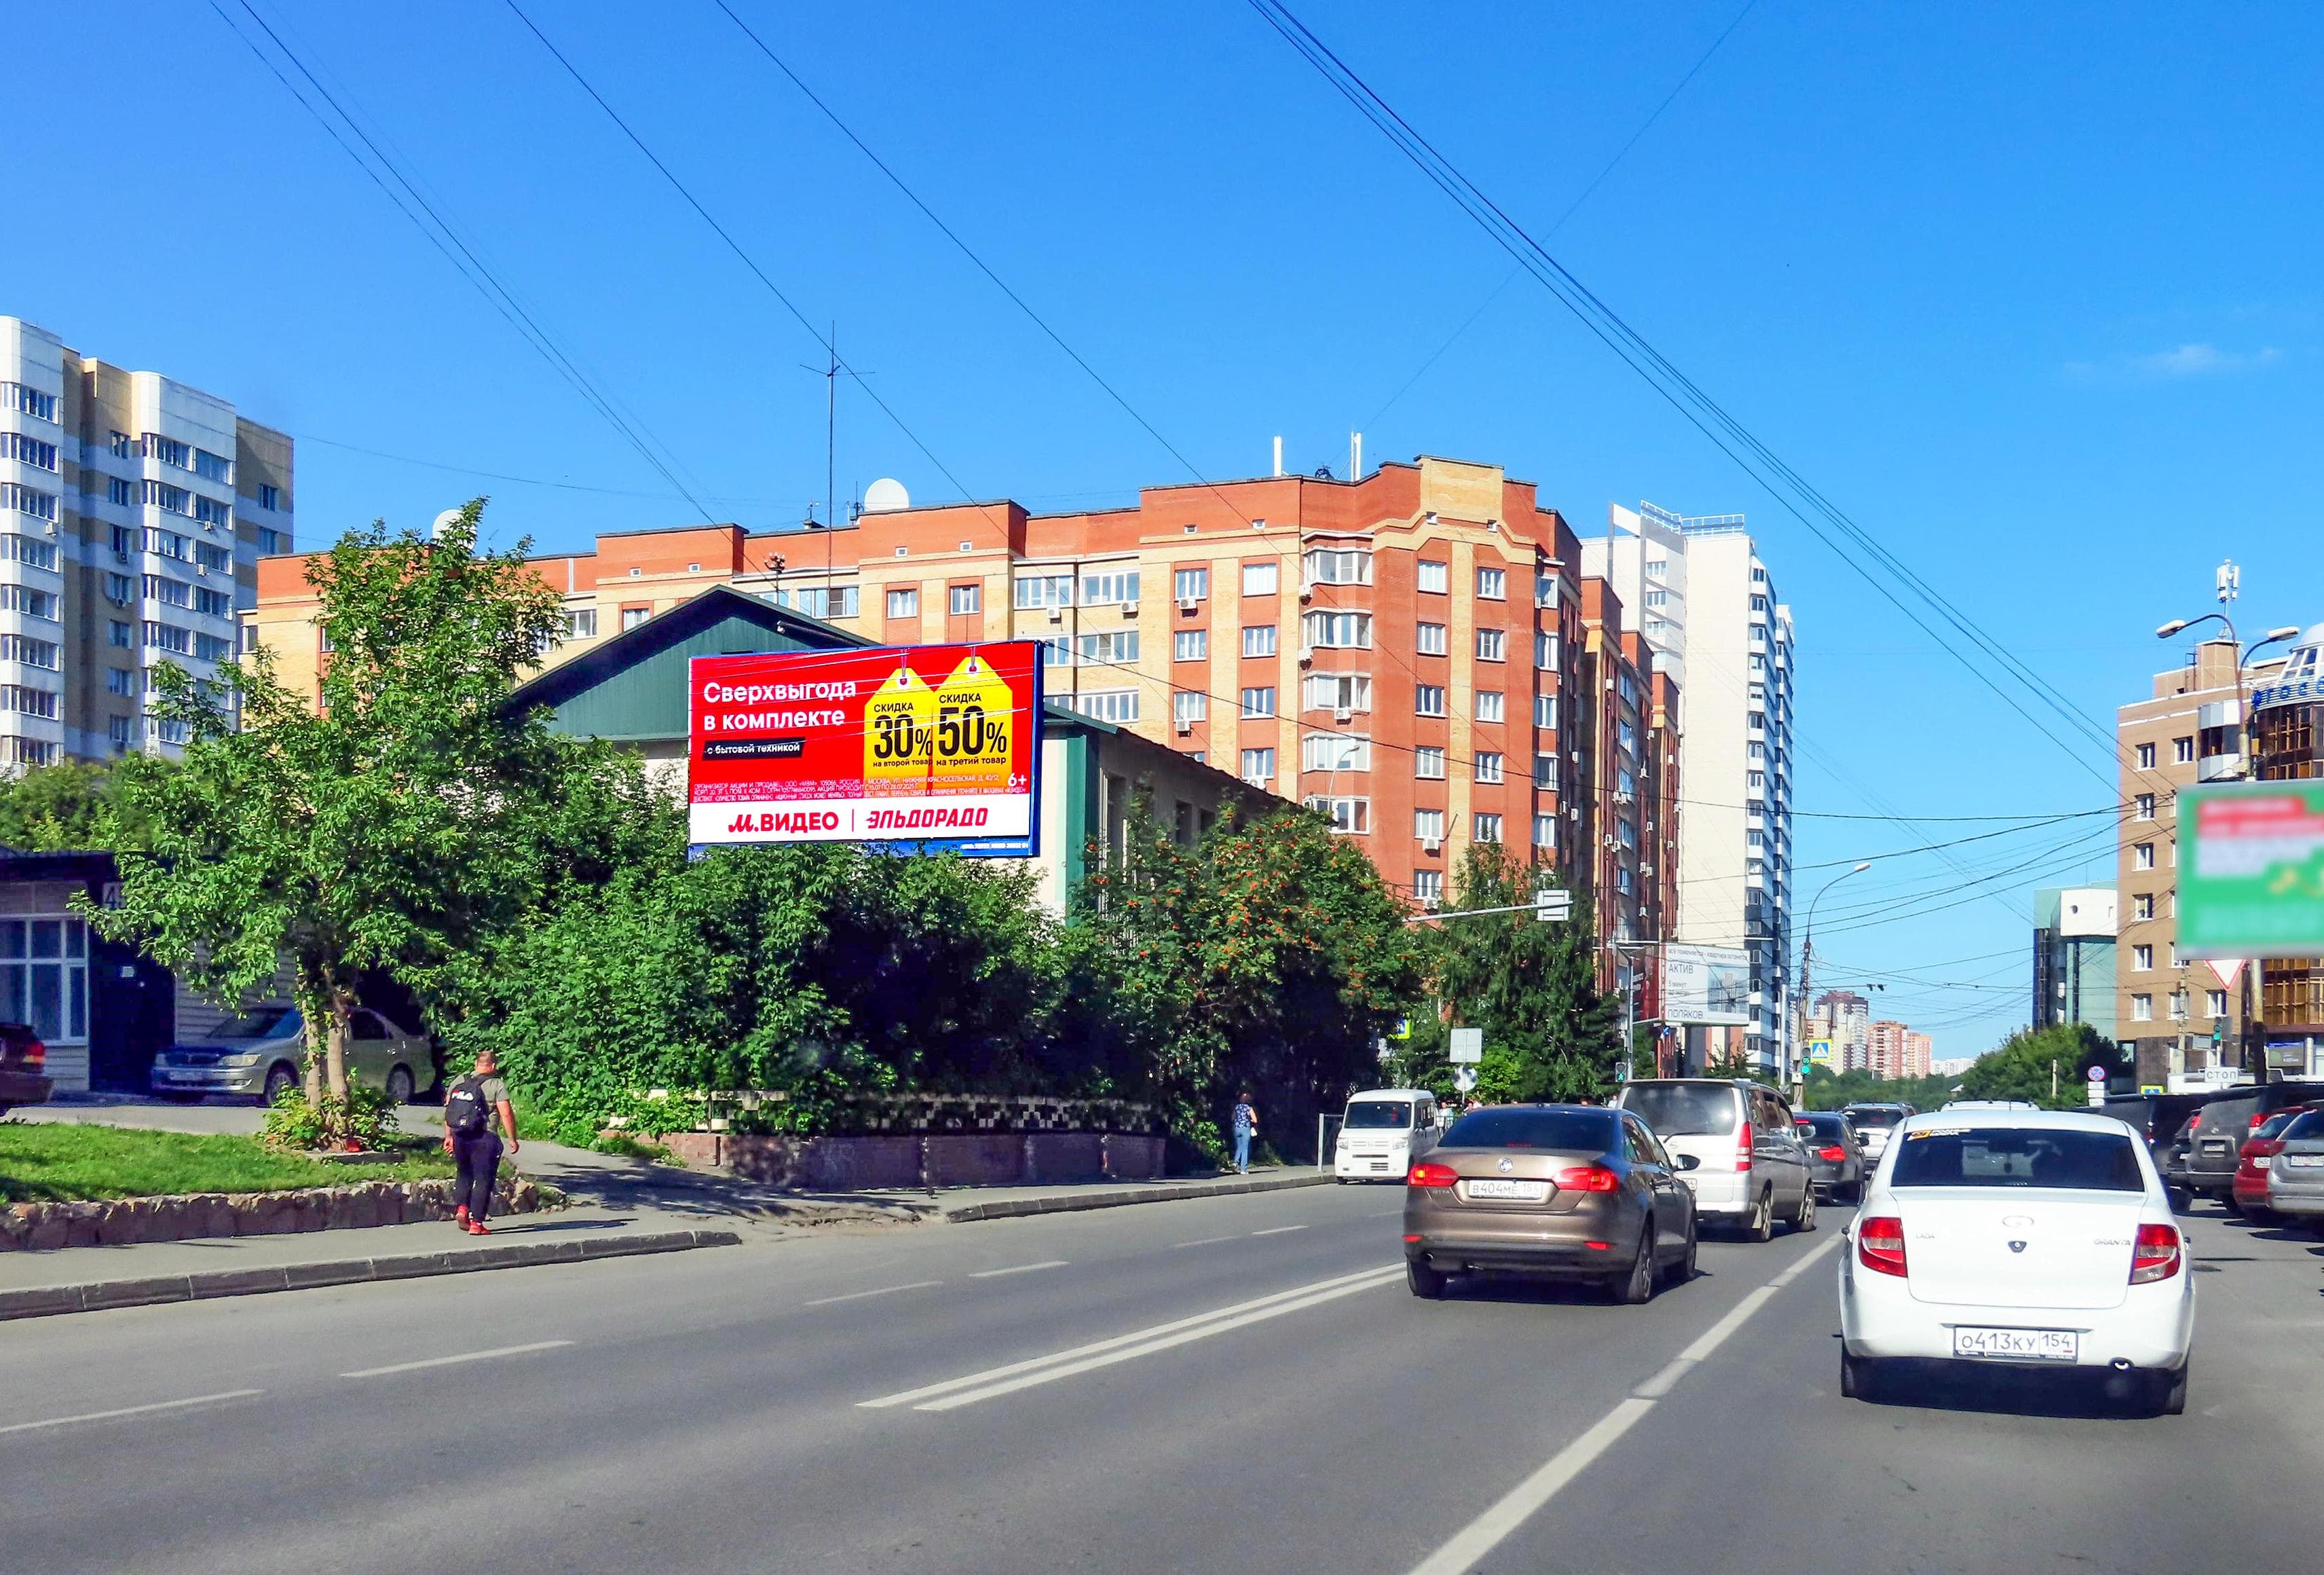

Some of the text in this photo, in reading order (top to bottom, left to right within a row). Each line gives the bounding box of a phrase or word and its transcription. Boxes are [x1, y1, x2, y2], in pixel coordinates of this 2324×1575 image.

[704, 682, 857, 705] Сверхвыгода
[939, 692, 981, 704] СКИДКА
[874, 702, 914, 713] СКИДКА
[704, 709, 846, 730] в комплекте
[874, 714, 933, 759] 30%
[938, 705, 1007, 756] 50%
[715, 743, 755, 755] бытовой
[757, 741, 800, 754] техникой
[883, 758, 910, 768] второй
[912, 758, 933, 766] товар
[948, 756, 979, 767] третий
[981, 756, 1007, 767] товар
[1007, 773, 1027, 787] 6+
[865, 808, 989, 830] ЭЛЬДОРАДО
[1668, 963, 1694, 974] АКТИВ
[1668, 1009, 1704, 1018] ПОЛЯКОВ
[2207, 1070, 2236, 1080] СТОП
[2041, 1333, 2070, 1348] 154
